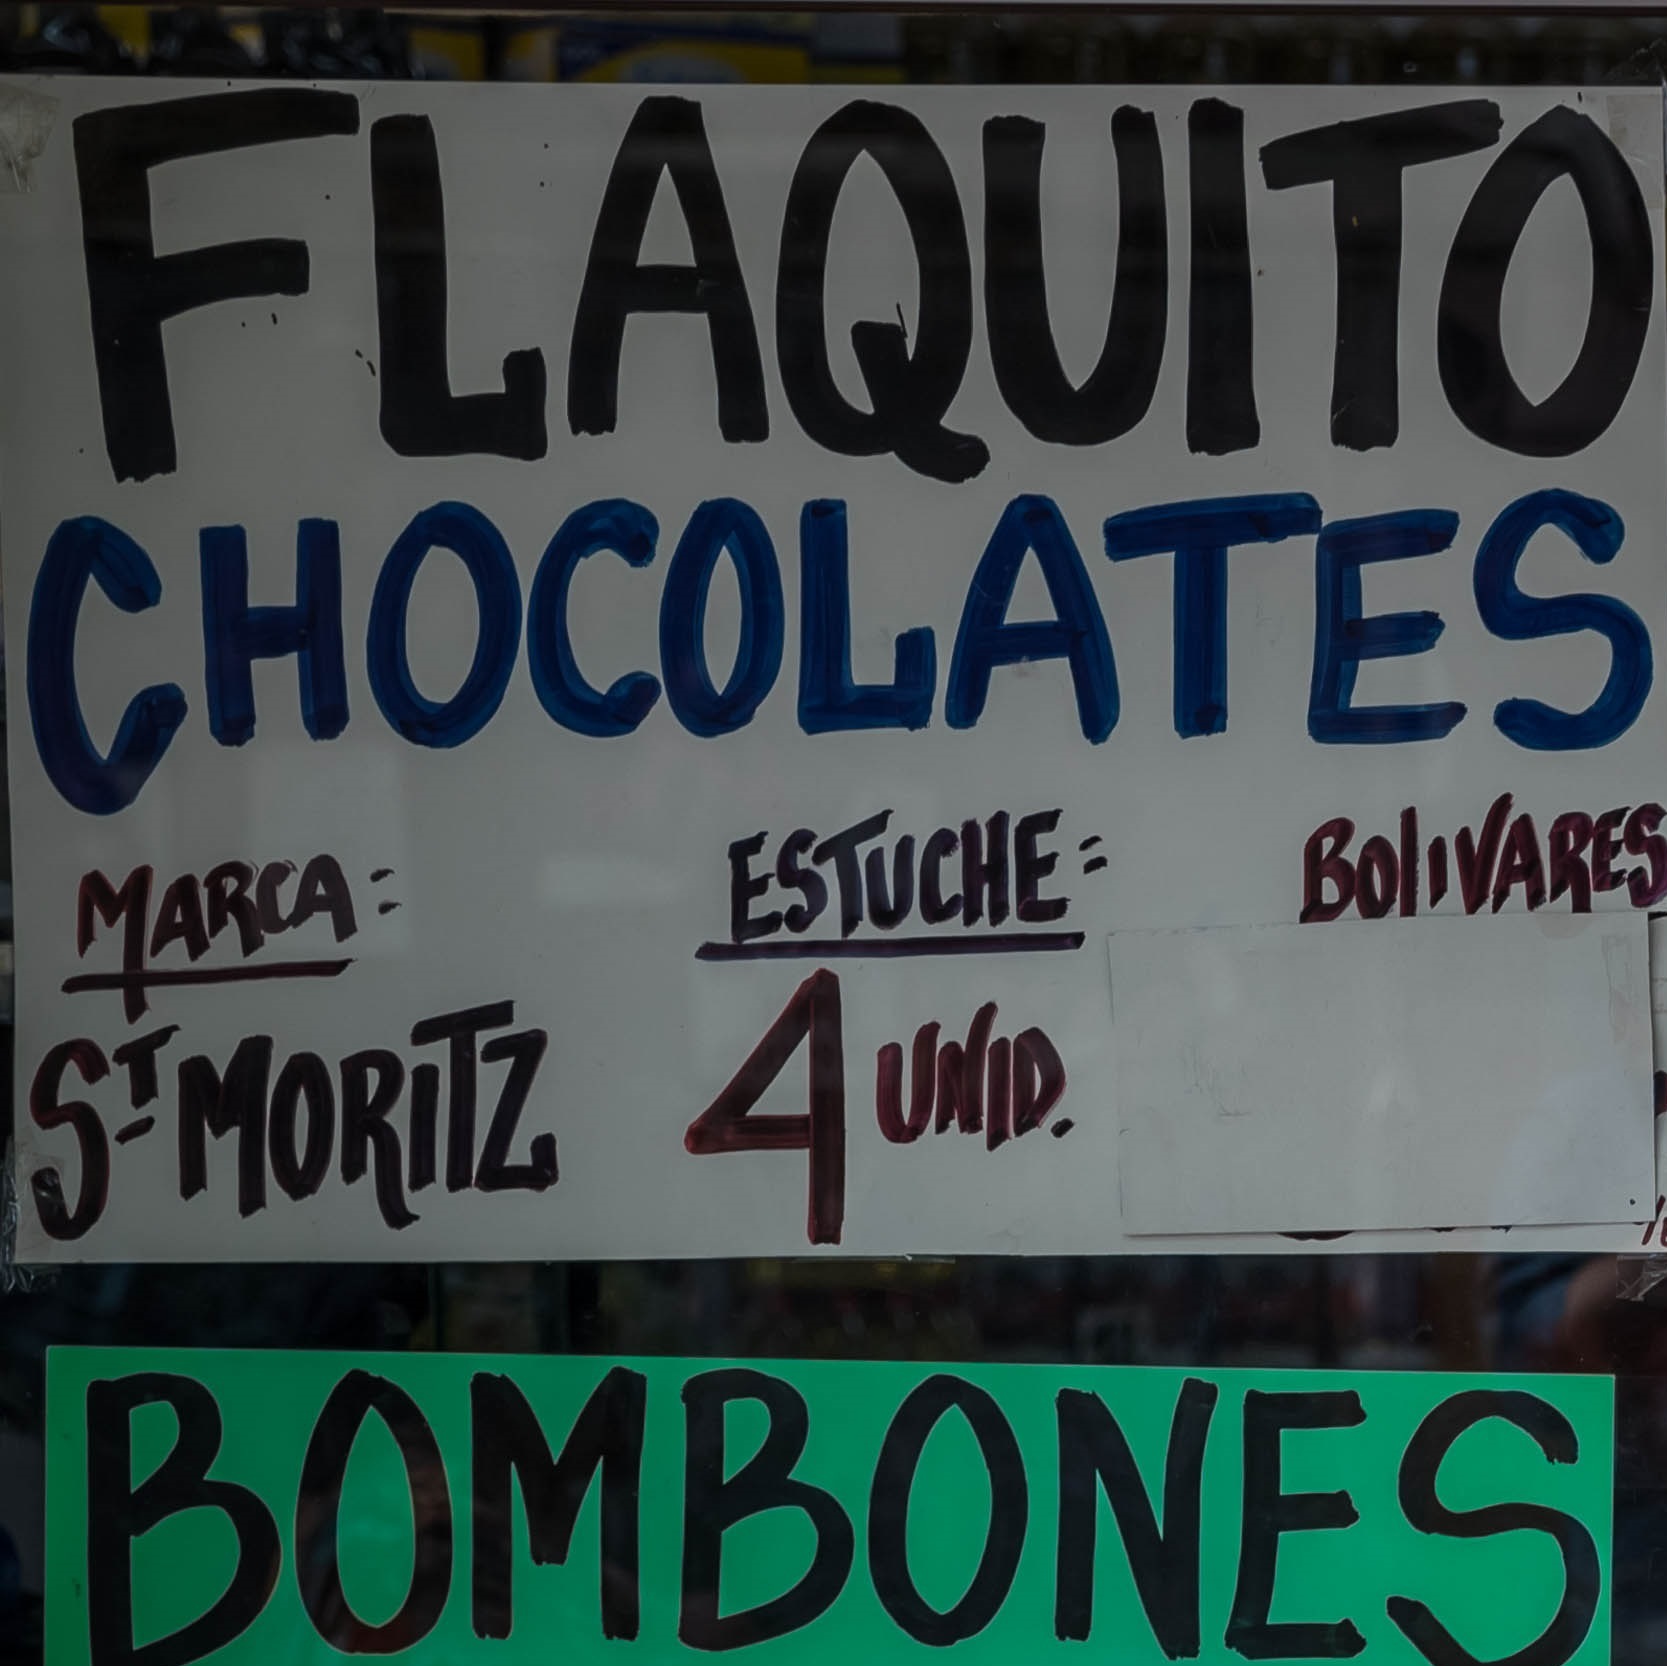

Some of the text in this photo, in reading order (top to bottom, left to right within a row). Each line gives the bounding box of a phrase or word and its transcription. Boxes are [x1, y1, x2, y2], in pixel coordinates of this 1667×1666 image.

[73, 87, 1653, 482] FLAQUITO
[28, 489, 1654, 815] CHOCOLATES
[78, 855, 397, 1023] MARCA:
[728, 807, 1108, 945] ESTUCHE:
[178, 1000, 559, 1230] MORITZ
[684, 969, 1075, 1245] 4 UNID.
